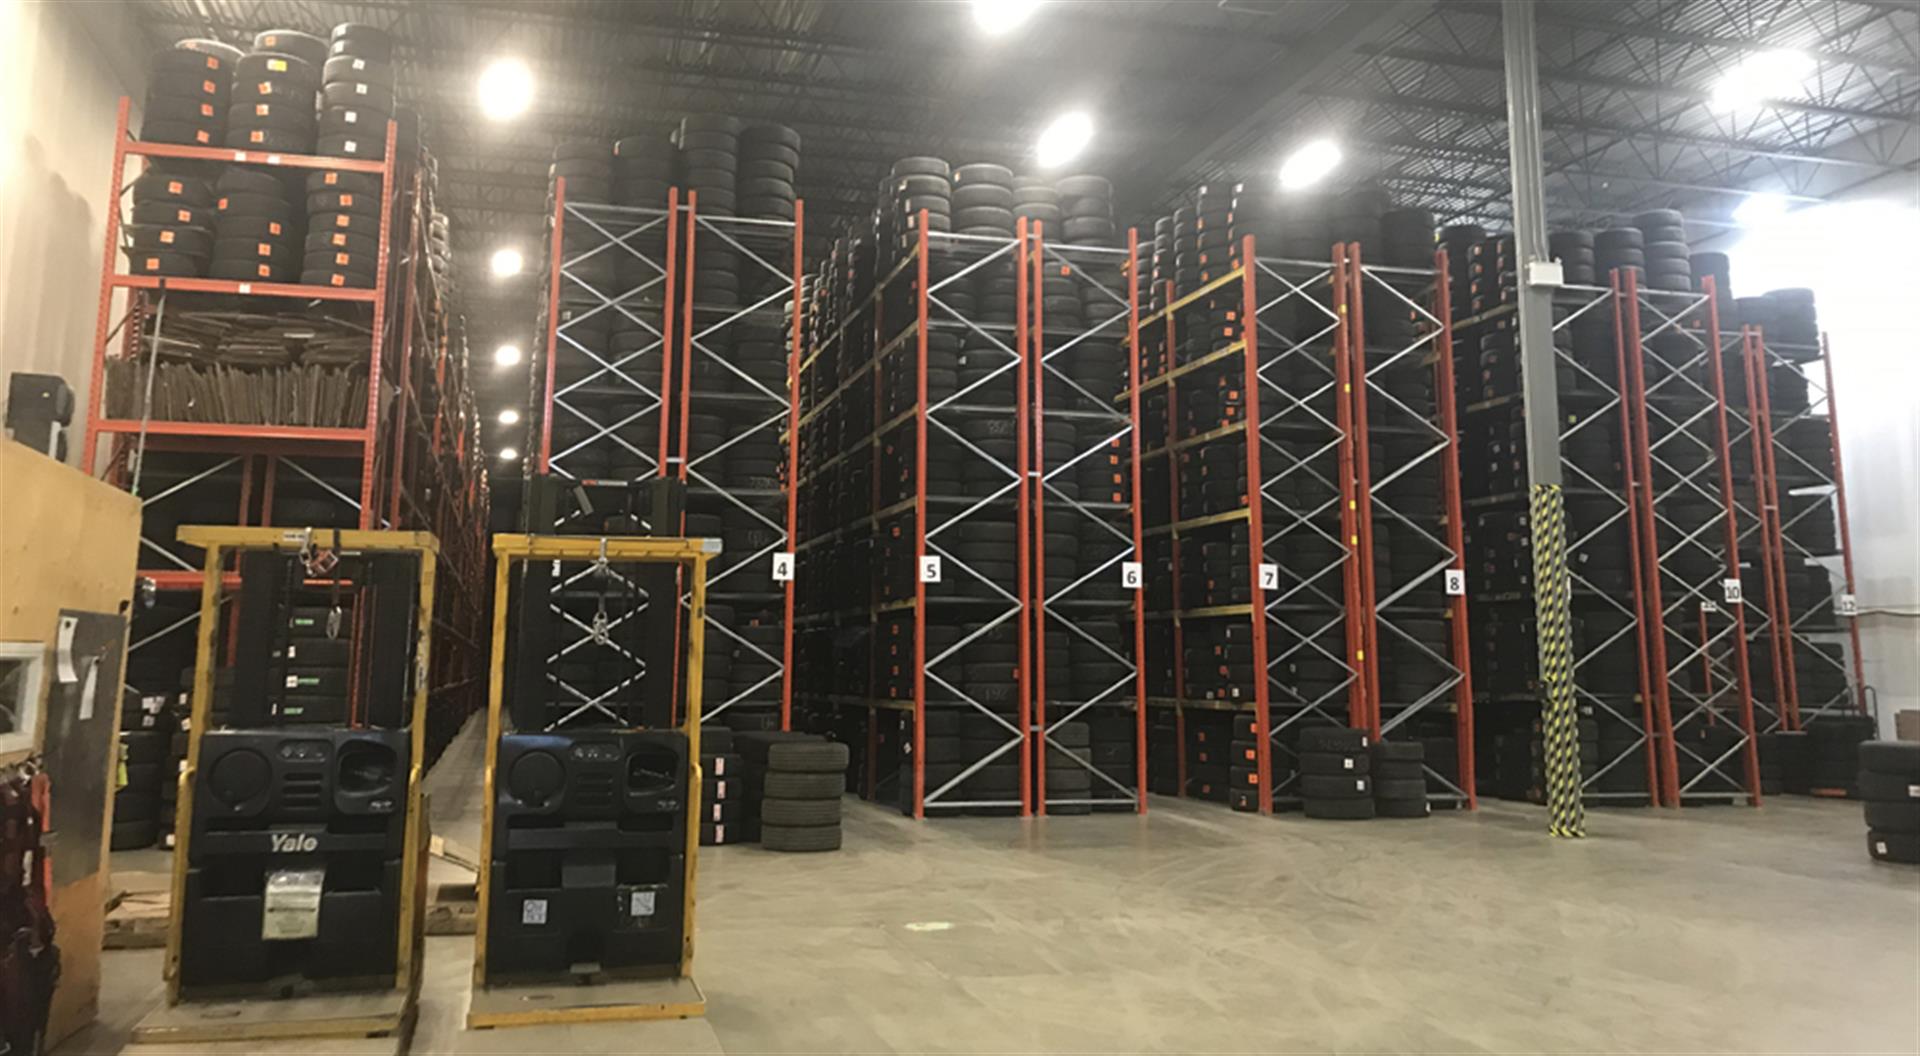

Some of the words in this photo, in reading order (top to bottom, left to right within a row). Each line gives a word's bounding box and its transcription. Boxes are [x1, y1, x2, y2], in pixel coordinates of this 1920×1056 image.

[777, 562, 788, 576] 4
[926, 564, 936, 578] 5
[1127, 571, 1137, 584] 6
[1264, 572, 1274, 585] 7
[1449, 577, 1459, 590] 8
[1726, 587, 1740, 599] 10
[271, 833, 318, 852] Yale
